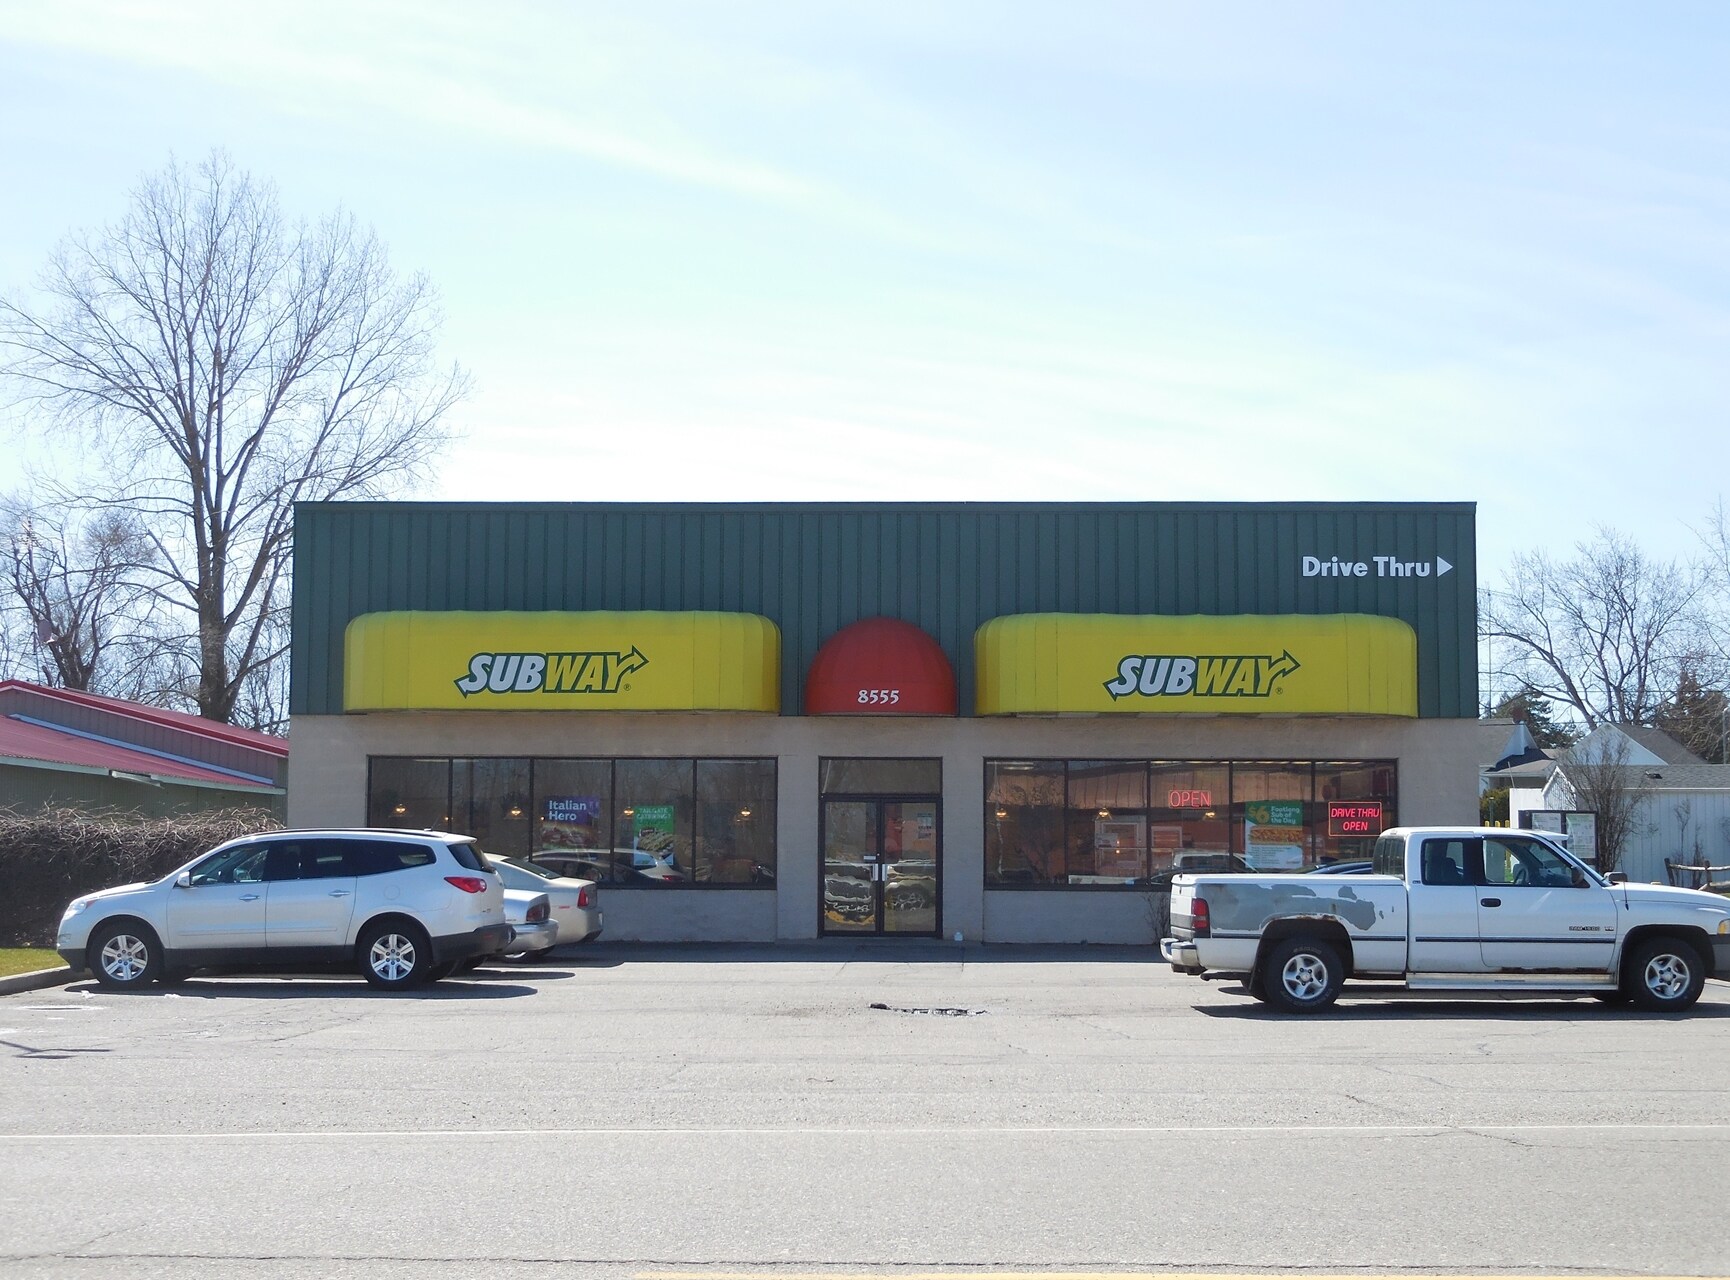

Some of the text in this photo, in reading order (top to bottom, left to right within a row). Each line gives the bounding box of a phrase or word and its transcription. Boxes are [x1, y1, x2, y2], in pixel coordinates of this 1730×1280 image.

[1302, 556, 1430, 577] Drive Thru
[455, 649, 646, 697] SUBWAY
[1103, 652, 1298, 700] SUBWAY
[857, 689, 900, 704] 8555
[548, 800, 587, 810] Italian
[1169, 791, 1211, 807] OPEN
[548, 810, 577, 821] Hero
[1331, 808, 1380, 818] DRIVE THRU
[1282, 817, 1297, 825] Day
[1342, 821, 1368, 831] OPEN
